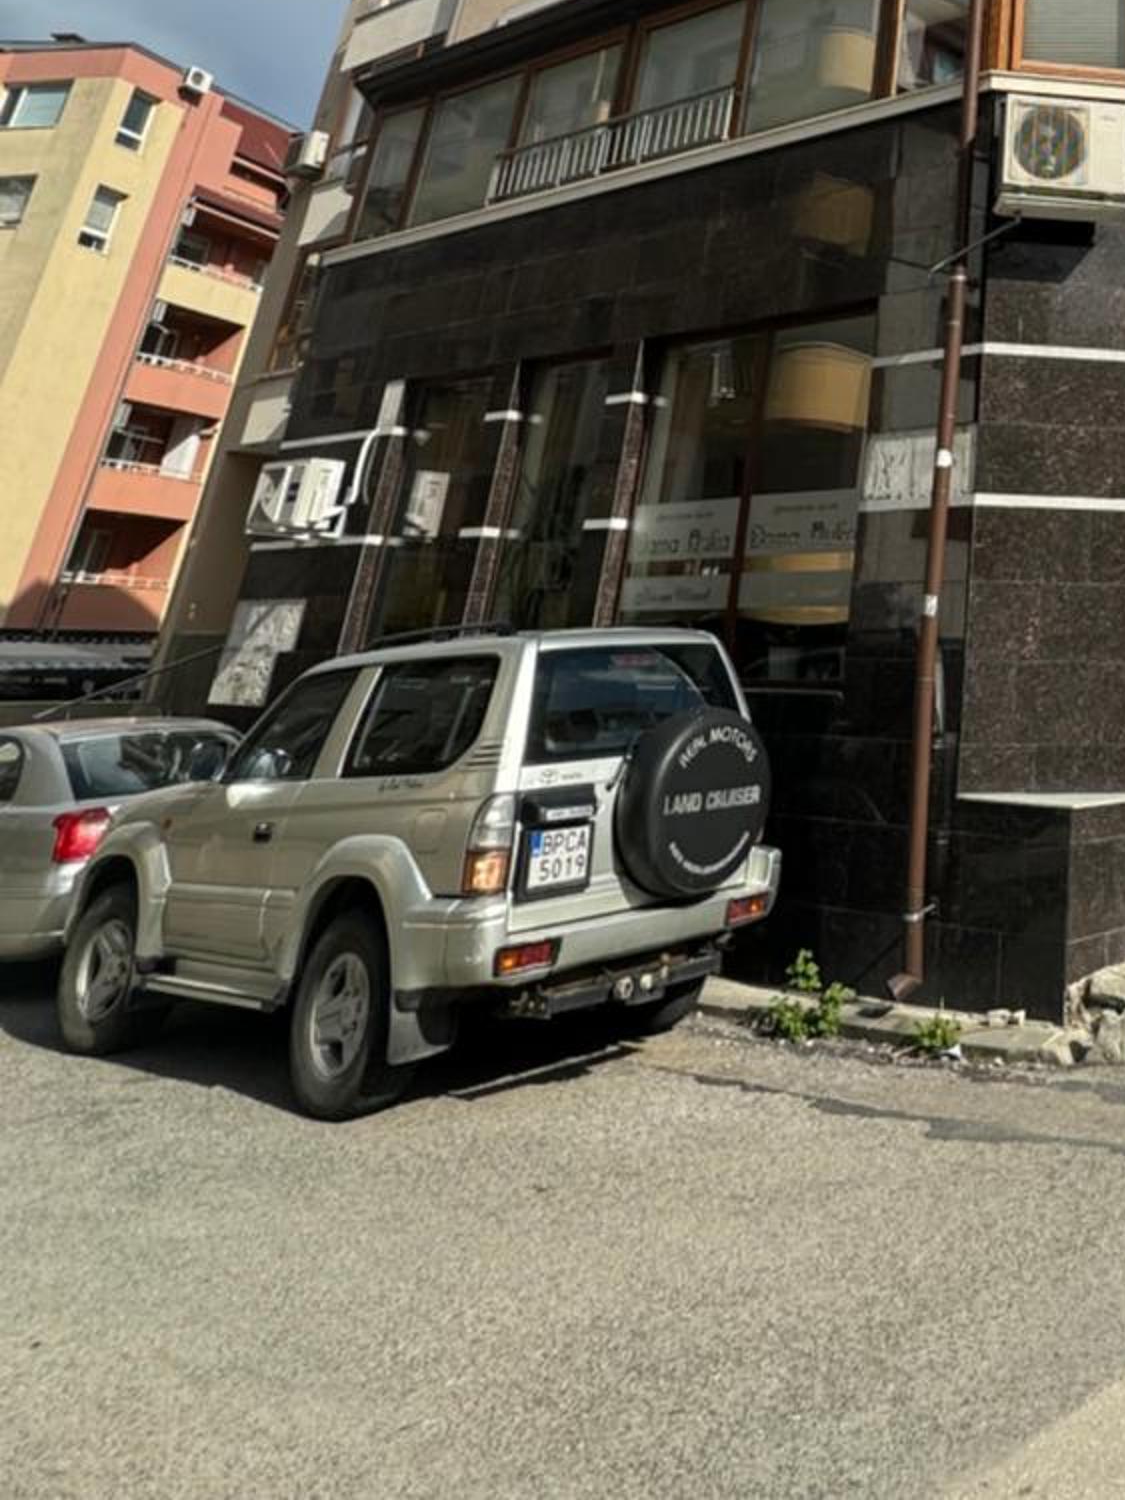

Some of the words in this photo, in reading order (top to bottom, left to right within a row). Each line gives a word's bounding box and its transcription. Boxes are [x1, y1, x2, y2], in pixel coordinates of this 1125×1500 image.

[709, 726, 758, 762] MOTORS
[663, 792, 702, 815] LAND
[705, 783, 761, 810] CRUISER
[539, 854, 586, 881] 5019
